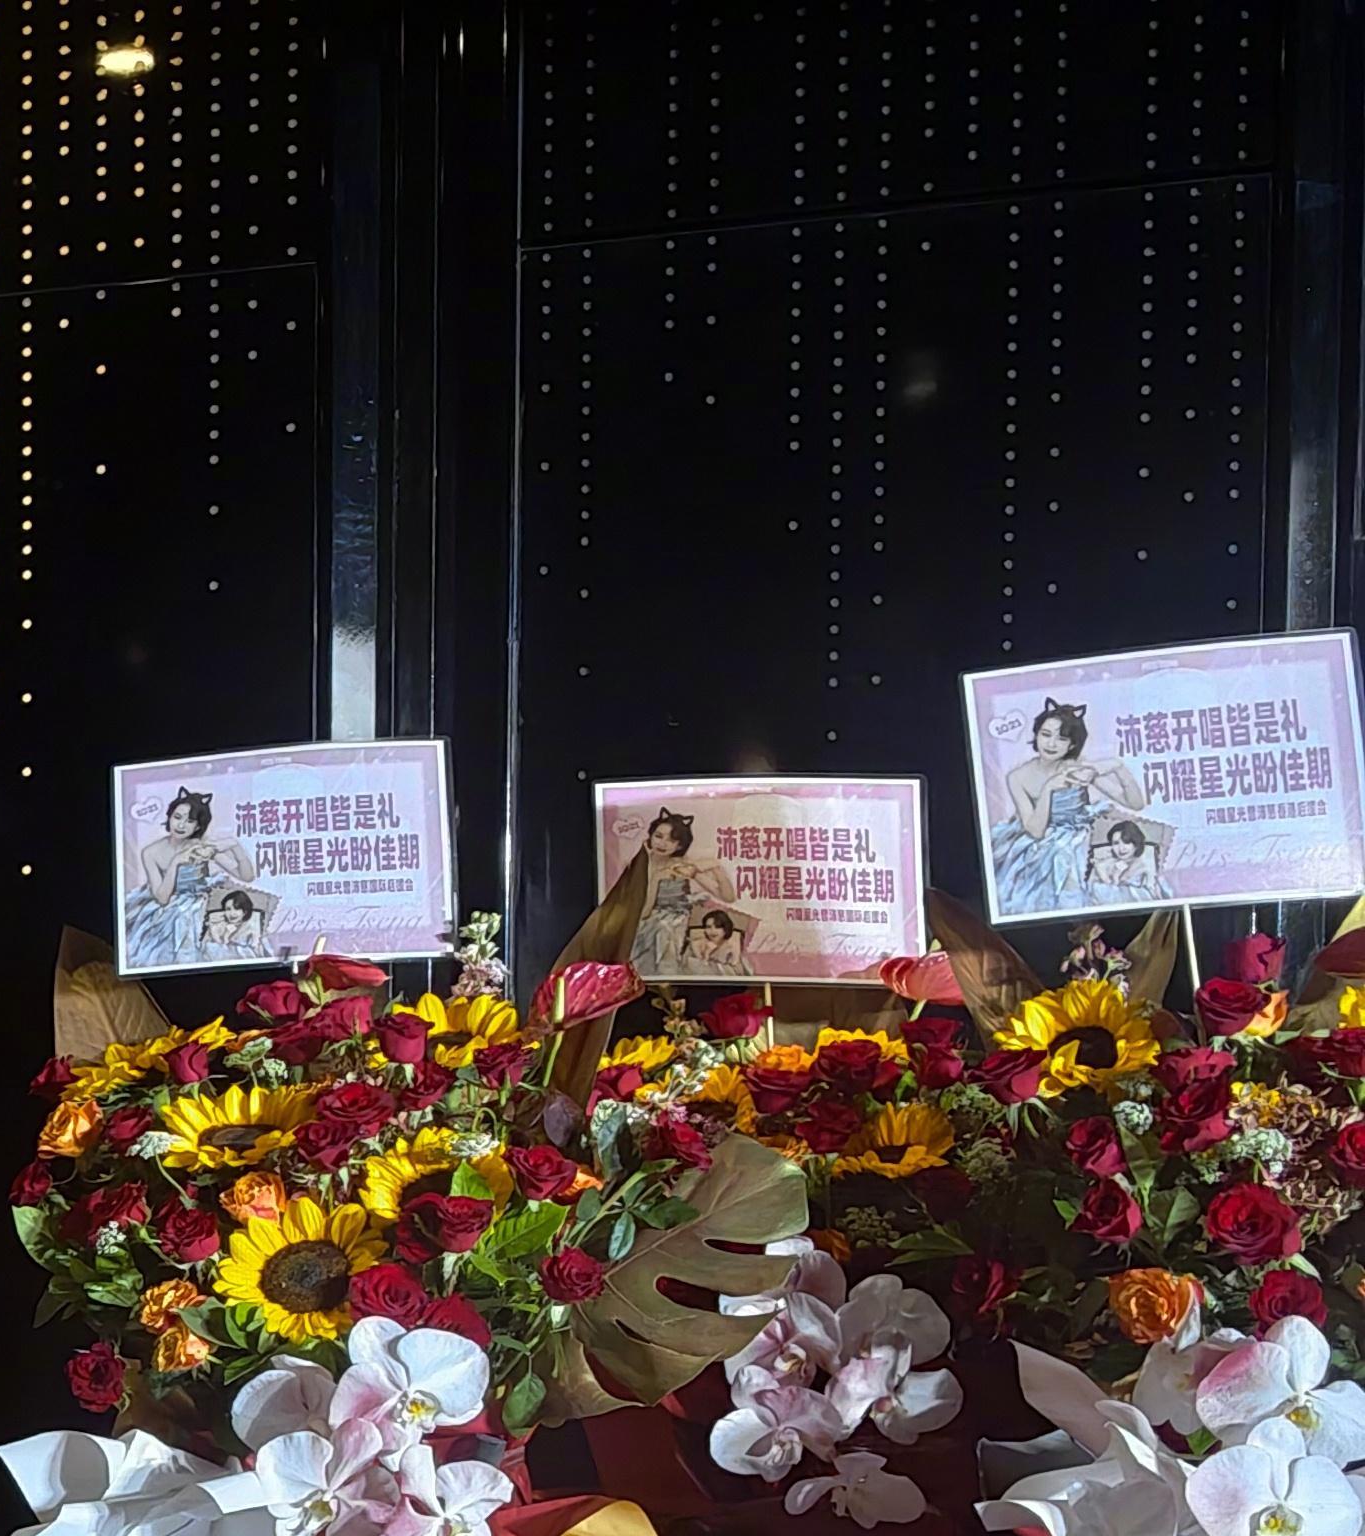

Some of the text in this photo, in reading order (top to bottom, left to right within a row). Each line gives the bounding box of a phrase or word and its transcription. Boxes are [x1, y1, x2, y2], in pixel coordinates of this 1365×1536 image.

[1115, 699, 1307, 757] 沛慈开唱皆是礼
[1142, 747, 1333, 805] 闪耀星光盼佳期
[235, 793, 400, 838] 沛慈开唱皆是礼
[255, 834, 421, 878] 闪耀星光盼佳期
[716, 827, 876, 863] 沛慈开唱皆是礼
[736, 866, 895, 904] 闪耀星光盼佳期
